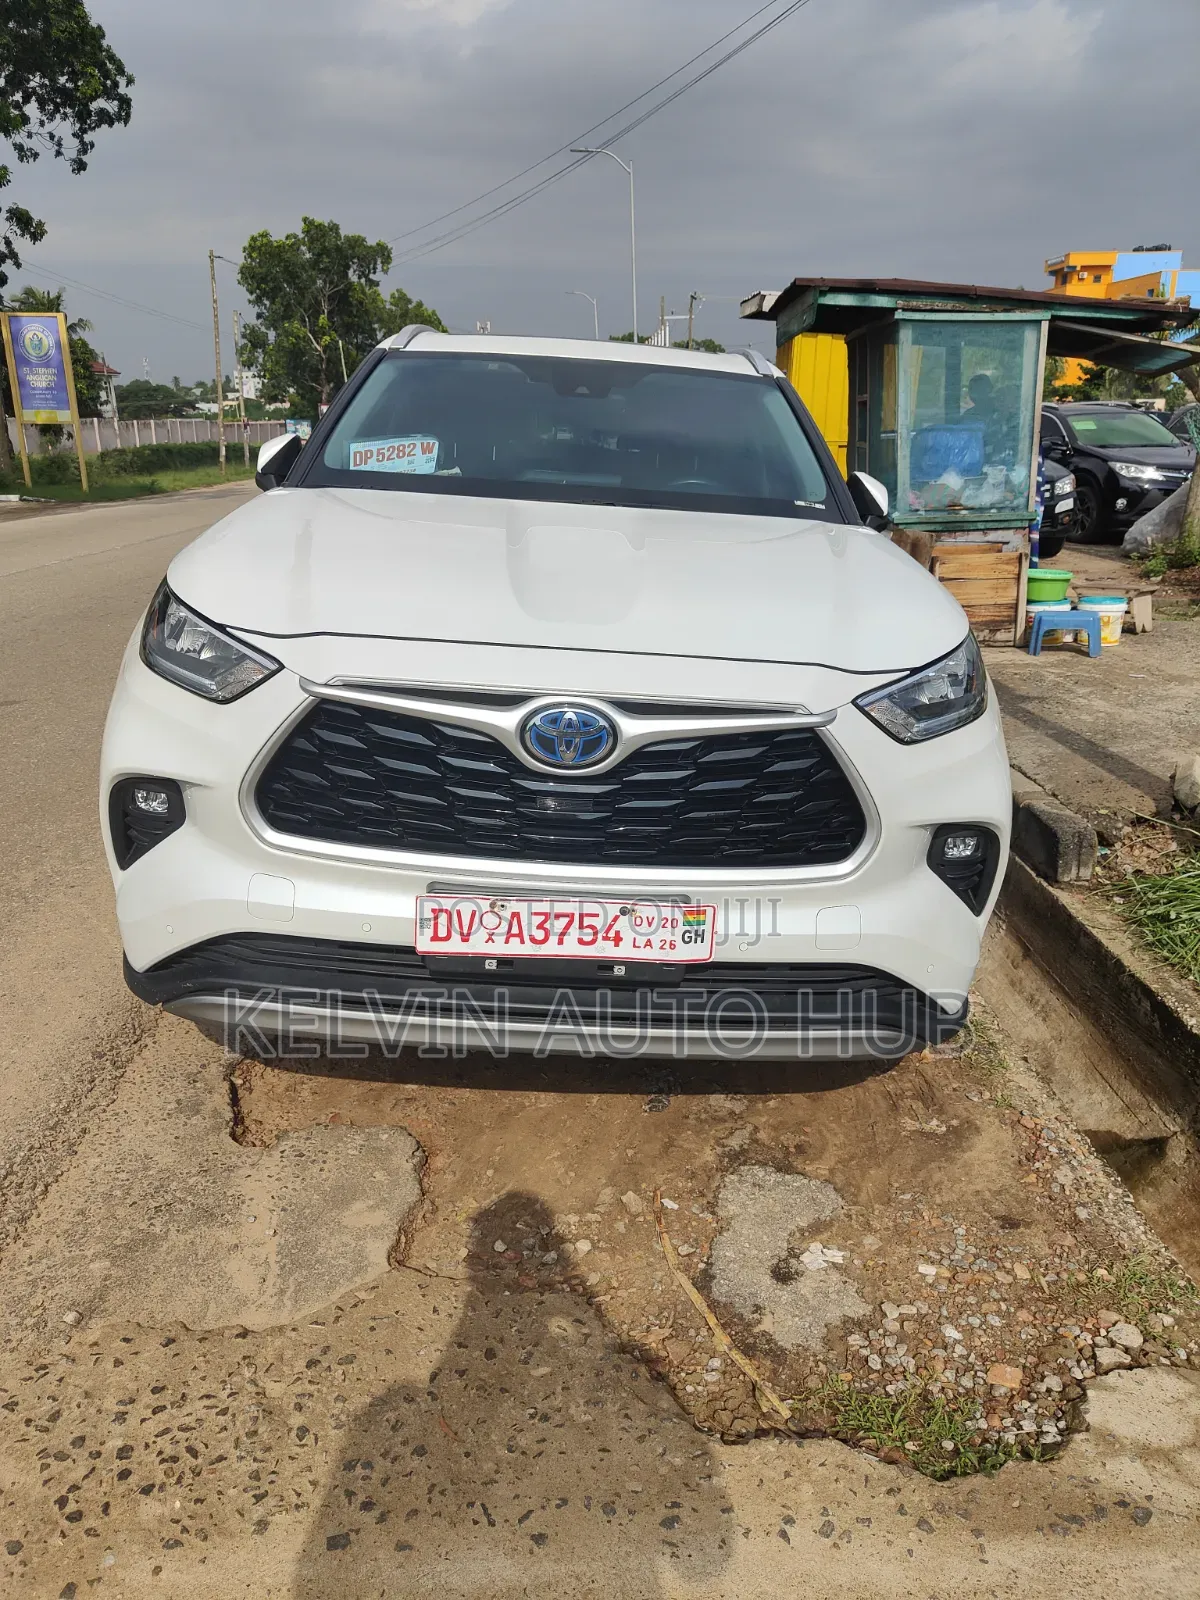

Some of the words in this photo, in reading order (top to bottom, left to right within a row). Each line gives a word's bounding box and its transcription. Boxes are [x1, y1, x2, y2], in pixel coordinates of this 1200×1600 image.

[32, 367, 58, 375] STEPHEN
[353, 449, 374, 468] DP
[375, 442, 417, 463] 5282
[420, 441, 436, 456] W
[430, 908, 477, 943] DV
[504, 911, 624, 948] A3754
[661, 916, 679, 929] 20
[632, 936, 653, 950] LA
[659, 938, 677, 950] 26
[681, 928, 706, 945] GH
